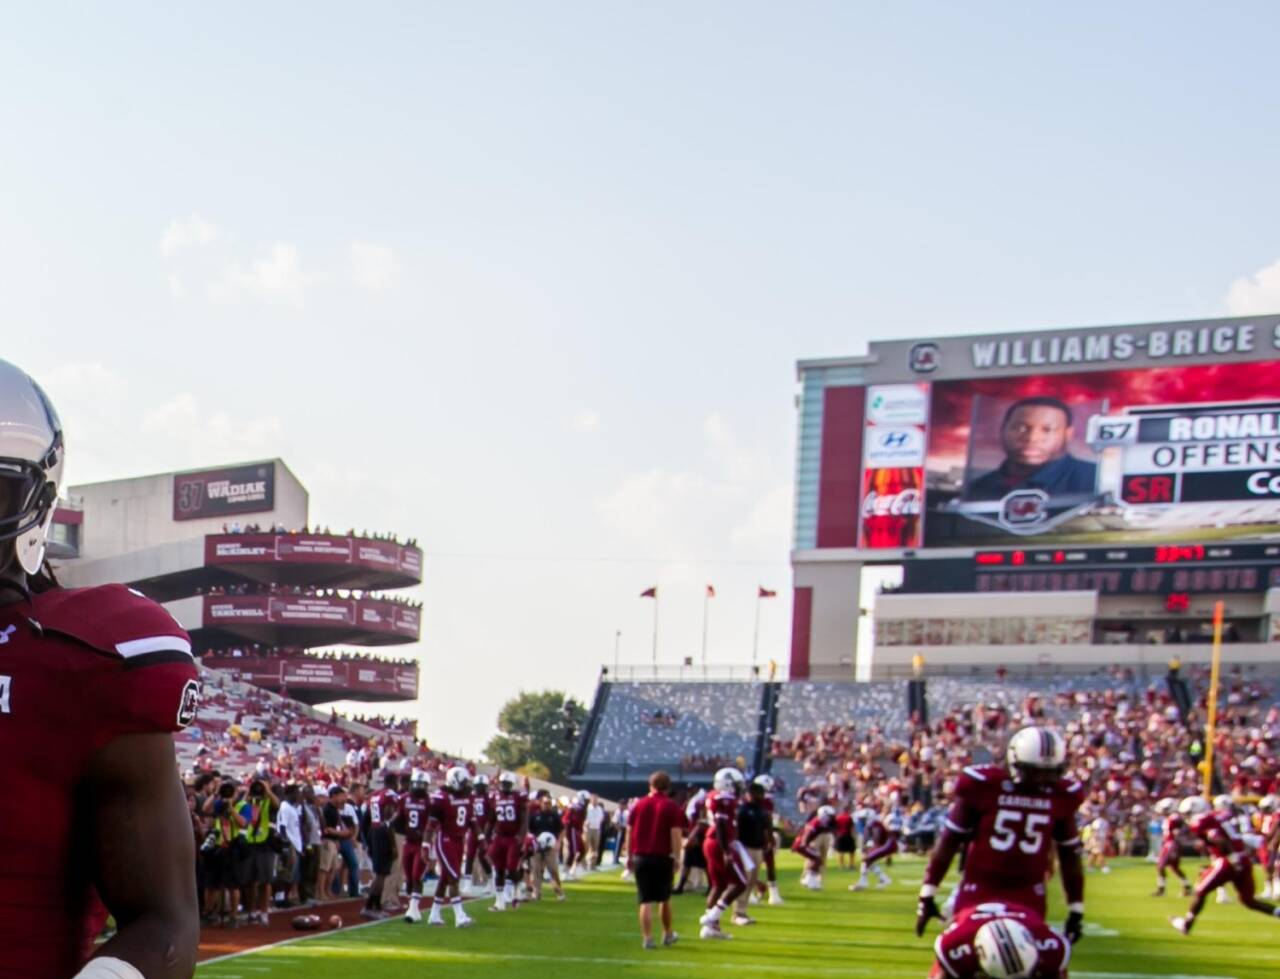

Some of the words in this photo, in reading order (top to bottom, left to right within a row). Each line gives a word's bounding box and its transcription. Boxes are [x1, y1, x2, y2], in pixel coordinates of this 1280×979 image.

[973, 325, 1255, 368] WILLIAMS-BRICE
[1099, 422, 1132, 441] 67
[1169, 413, 1280, 442] RONAL
[208, 482, 266, 499] WADIAK
[1127, 475, 1172, 503] SR
[408, 810, 419, 829] 9
[456, 806, 467, 827] 8
[989, 809, 1051, 855] 55
[948, 943, 972, 960] 5
[1036, 938, 1060, 951] 5
